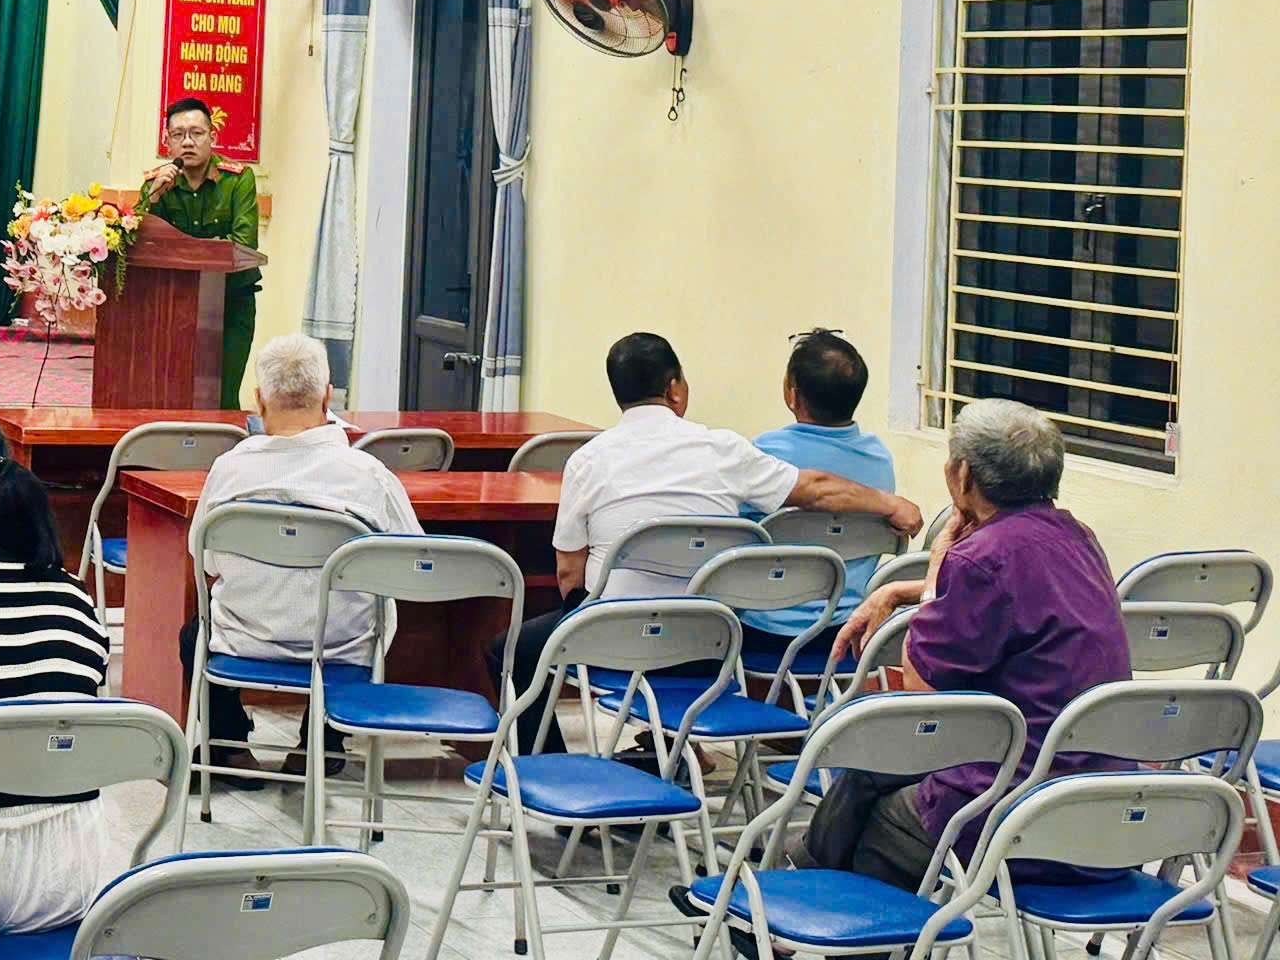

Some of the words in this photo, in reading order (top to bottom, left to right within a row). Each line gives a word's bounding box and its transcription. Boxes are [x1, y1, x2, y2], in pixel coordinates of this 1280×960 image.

[191, 13, 214, 33] CHO
[218, 15, 241, 38] MỌI
[181, 40, 212, 62] HÀNH
[216, 41, 248, 67] ĐỘNG
[183, 65, 206, 91] CỦA
[210, 66, 242, 93] ĐẢNG
